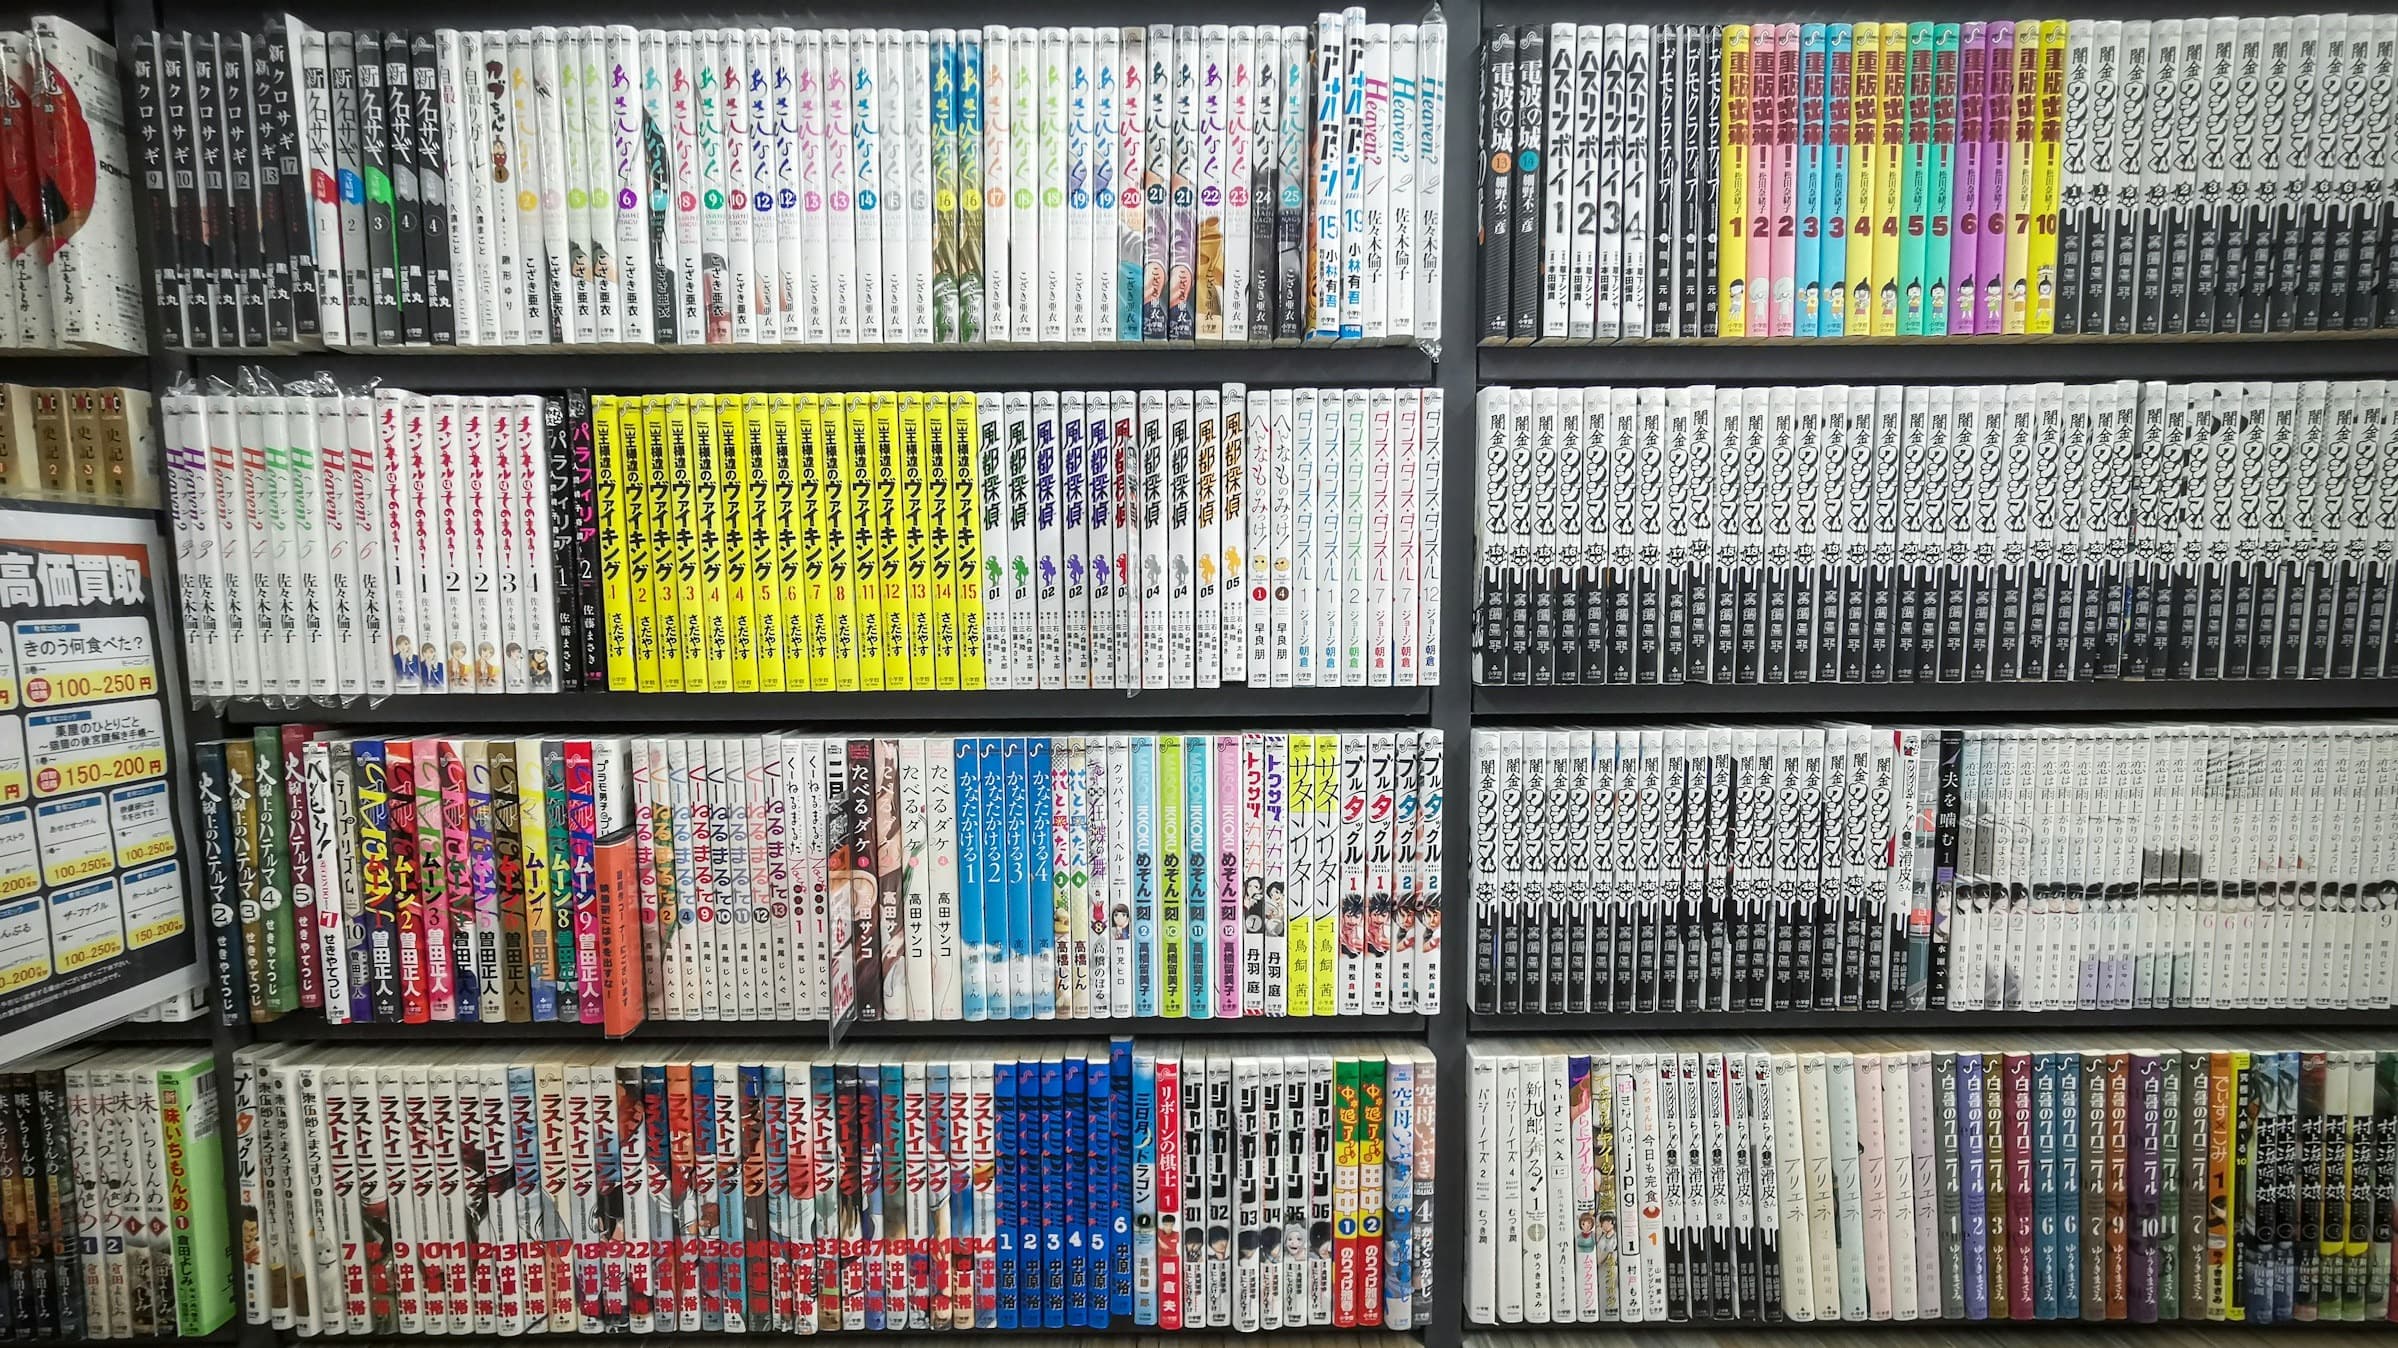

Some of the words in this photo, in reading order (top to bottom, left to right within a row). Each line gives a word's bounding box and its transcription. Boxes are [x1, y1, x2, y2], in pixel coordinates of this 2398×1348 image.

[134, 60, 160, 166] 新クロサギ
[165, 60, 189, 166] 新クロサギ
[270, 44, 295, 150] 新クロサギ
[305, 68, 329, 167] 新クロサギ
[359, 65, 384, 166] 新クロサギ
[414, 68, 440, 168] 新クロサギ
[700, 64, 723, 183] あさひなぐ
[751, 67, 774, 183] あさひなぐ
[855, 65, 879, 183] あさひなぐ
[932, 64, 956, 185] あさひなぐ
[1122, 65, 1146, 182] あさひなぐ
[1392, 75, 1416, 165] Heaven?
[1491, 62, 1514, 153] 電波の城
[1518, 60, 1543, 151] 電波の城
[1550, 48, 1572, 196] ハスリンボーイ
[1575, 50, 1599, 197] ハスリンボーイ
[1602, 50, 1625, 198] ハスリンボーイ
[1626, 51, 1648, 199] ハスリンボーイ
[1729, 51, 1749, 170] 重版出来!
[1803, 51, 1825, 169] 重版出来!
[2041, 48, 2064, 168] 重版出来!
[2089, 45, 2115, 173] 闇金ウシジマくん
[2202, 42, 2232, 170] 闇金ウシジマくん
[2363, 41, 2393, 168] 闇金ウシジマくん
[610, 64, 638, 183] あさひなぐ
[625, 256, 639, 321] こざき亜衣
[1124, 191, 1140, 205] 20
[1577, 202, 1597, 235] 2
[1602, 201, 1620, 235] 3
[1753, 217, 1769, 238] 2
[1802, 216, 1819, 237] 3
[1854, 215, 1871, 237] 4
[1908, 215, 1924, 237] 5
[1960, 213, 1977, 235] 6
[2036, 213, 2057, 235] 10
[1325, 249, 1338, 308] 小林有吾
[1348, 243, 1361, 304] 小林有吾
[1367, 209, 1383, 284] 佐々木倫子
[1395, 208, 1411, 282] 佐々木倫子
[438, 415, 459, 569] チャンネルはそのまま!
[497, 416, 516, 569] チャンネルはそのまま!
[572, 423, 596, 543] パラフィリア
[981, 419, 1002, 531] 風都探偵
[1036, 419, 1056, 531] 風都探偵
[1171, 419, 1191, 530] 風都探偵
[1224, 411, 1244, 522] 風都探偵
[1250, 414, 1269, 551] へんなものみっけ!
[1297, 410, 1313, 582] ダンス・ダンス・ダンスール
[1424, 410, 1441, 581] ダンス・ダンス・ダンスール
[1486, 413, 1509, 534] 闇金ウシジマくん
[1690, 409, 1713, 529] 闇金ウシジマくん
[1741, 414, 1766, 535] 闇金ウシジマくん
[2293, 408, 2323, 530] 闇金ウシジマくん
[0, 550, 146, 608] 高価買取
[350, 446, 374, 532] Heaven?
[363, 573, 384, 644] 佐々木倫子
[962, 583, 977, 599] 15
[1174, 586, 1187, 600] 04
[24, 635, 144, 658] きのう何食べた?
[612, 612, 625, 657] さだやす
[763, 613, 776, 659] さだやす
[967, 612, 977, 657] さだやす
[1254, 622, 1266, 661] 早良朋
[1299, 609, 1310, 669] ジョージ朝倉
[1425, 607, 1437, 667] ジョージ朝倉
[199, 771, 229, 902] 火線上のハテルマ
[255, 754, 279, 887] 火線上のハテルマ
[688, 765, 714, 903] くーねるまるた
[707, 767, 732, 905] くーねるまるた
[763, 761, 788, 900] くーねるまるた
[851, 764, 873, 853] たべるダケ
[904, 764, 921, 853] たべるダケ
[960, 770, 979, 861] かなたかける
[983, 770, 1003, 861] かなたかける
[1007, 770, 1026, 861] かなたかける
[1069, 769, 1087, 867] 花と奥たん
[1246, 751, 1262, 875] トクサツガガガ
[1290, 756, 1313, 922] サターンリターン
[1315, 756, 1339, 922] サターンリターン
[1343, 755, 1365, 865] ブルタックル
[1424, 754, 1443, 864] ブルタックル
[1476, 759, 1498, 873] 闇金ウシジマくん
[1938, 771, 1960, 848] 夫を噛む
[394, 856, 415, 909] ムーン
[526, 853, 546, 906] ムーン
[909, 893, 923, 958] 高田サンコ
[1135, 853, 1152, 921] めぞん一刻
[266, 920, 278, 996] せきやてつじ
[324, 934, 340, 1000] せきやてつじ
[372, 931, 393, 997] 曽田正人
[400, 932, 419, 997] 曽田正人
[579, 934, 599, 998] 曽田正人
[1074, 940, 1088, 990] 高橋しん
[1268, 951, 1281, 998] 丹羽庭
[1294, 939, 1308, 998] 鳥飼茜
[137, 1091, 164, 1205] 味いちもんめ
[568, 1096, 593, 1197] ラストイニング
[905, 1093, 927, 1193] ラストイニング
[973, 1092, 995, 1192] ラストイニング
[1159, 1085, 1177, 1189] リボーンの棋士
[1478, 1088, 1490, 1164] バジーノイズ
[1942, 1077, 1959, 1193] 白暮のクロニクル
[1968, 1077, 1985, 1193] 白暮のクロニクル
[2015, 1077, 2031, 1193] 白暮のクロニクル
[2112, 1074, 2126, 1194] 白暮のクロニクル
[326, 1096, 353, 1197] ラストイニング
[341, 1243, 357, 1260] 7
[380, 1095, 405, 1197] ラストイニング
[393, 1242, 410, 1258] 9
[1211, 1204, 1228, 1221] 02
[1240, 1210, 1258, 1227] 03
[1312, 1202, 1330, 1219] 06
[1972, 1217, 1984, 1235] 2
[2112, 1215, 2124, 1235] 9
[574, 1242, 600, 1260] 18
[2141, 1217, 2159, 1238] 10
[1001, 1259, 1016, 1310] 中原裕
[1025, 1259, 1040, 1310] 中原裕
[1533, 1252, 1543, 1308] ゆうきまさみ
